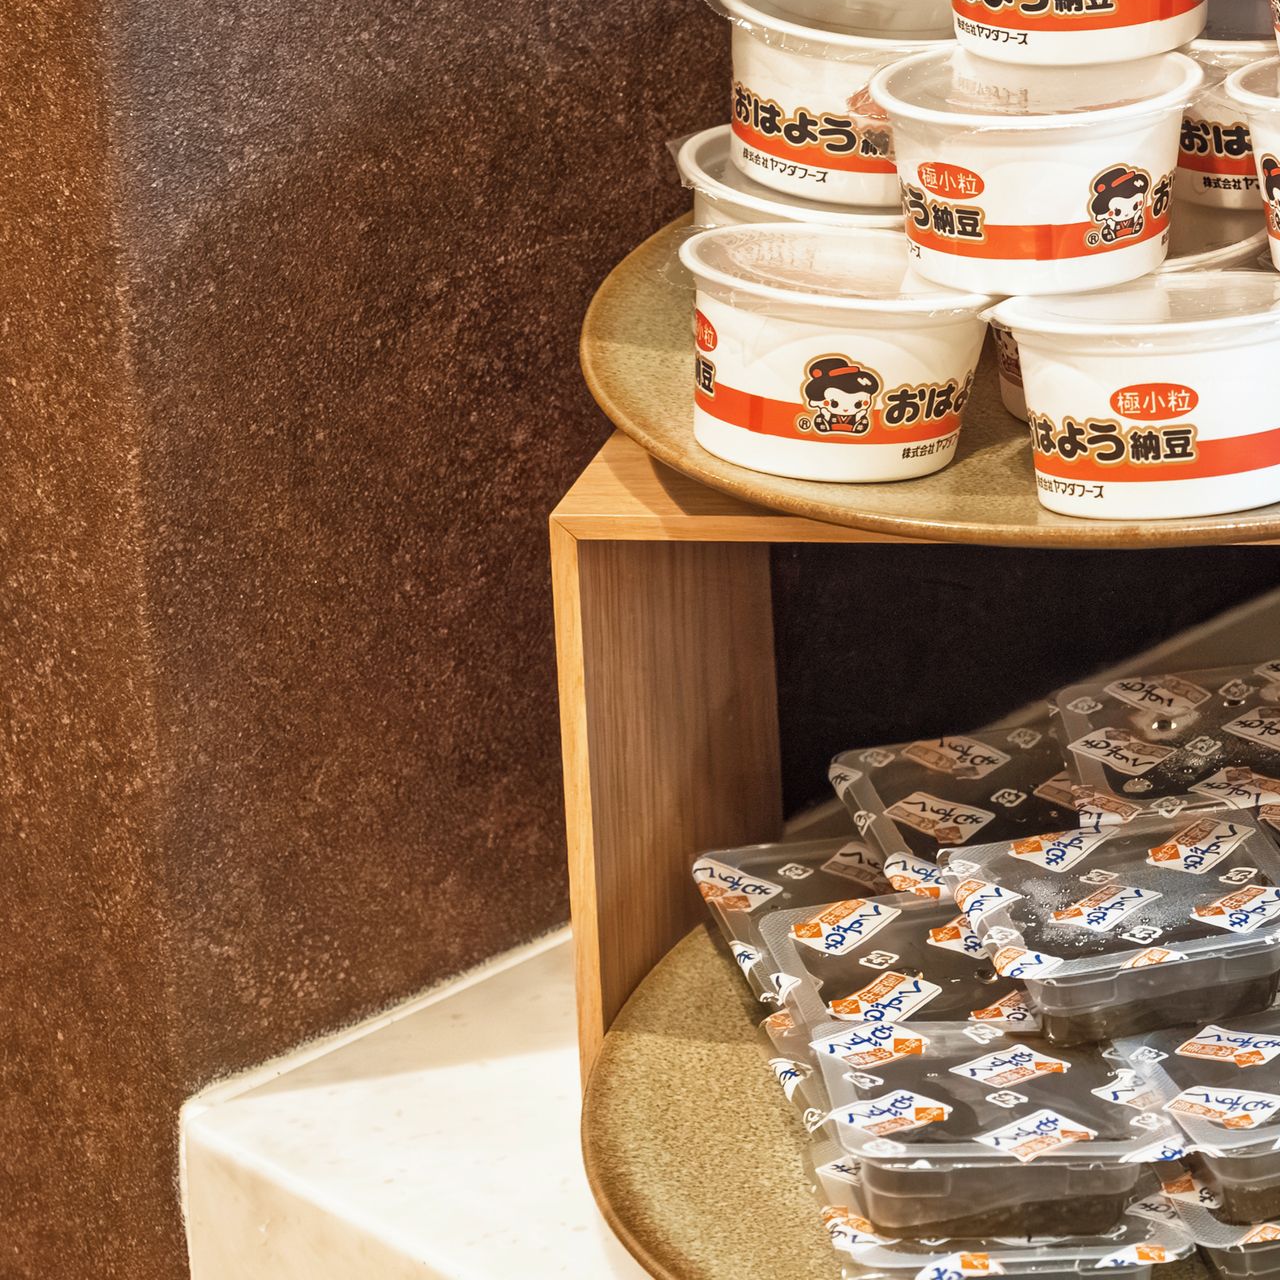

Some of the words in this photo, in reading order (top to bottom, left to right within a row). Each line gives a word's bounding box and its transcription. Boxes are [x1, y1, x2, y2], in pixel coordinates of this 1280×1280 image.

[921, 167, 979, 195] 極小粒
[1117, 391, 1192, 414] 極小粒
[1184, 824, 1237, 870] もずく
[1087, 888, 1143, 925] もずく
[824, 903, 882, 951] もずく
[829, 1025, 895, 1055] もずく
[970, 1051, 1034, 1077] もずく
[848, 1094, 914, 1125] もずく
[1184, 1092, 1274, 1112] もずく
[994, 1116, 1060, 1147] もずく
